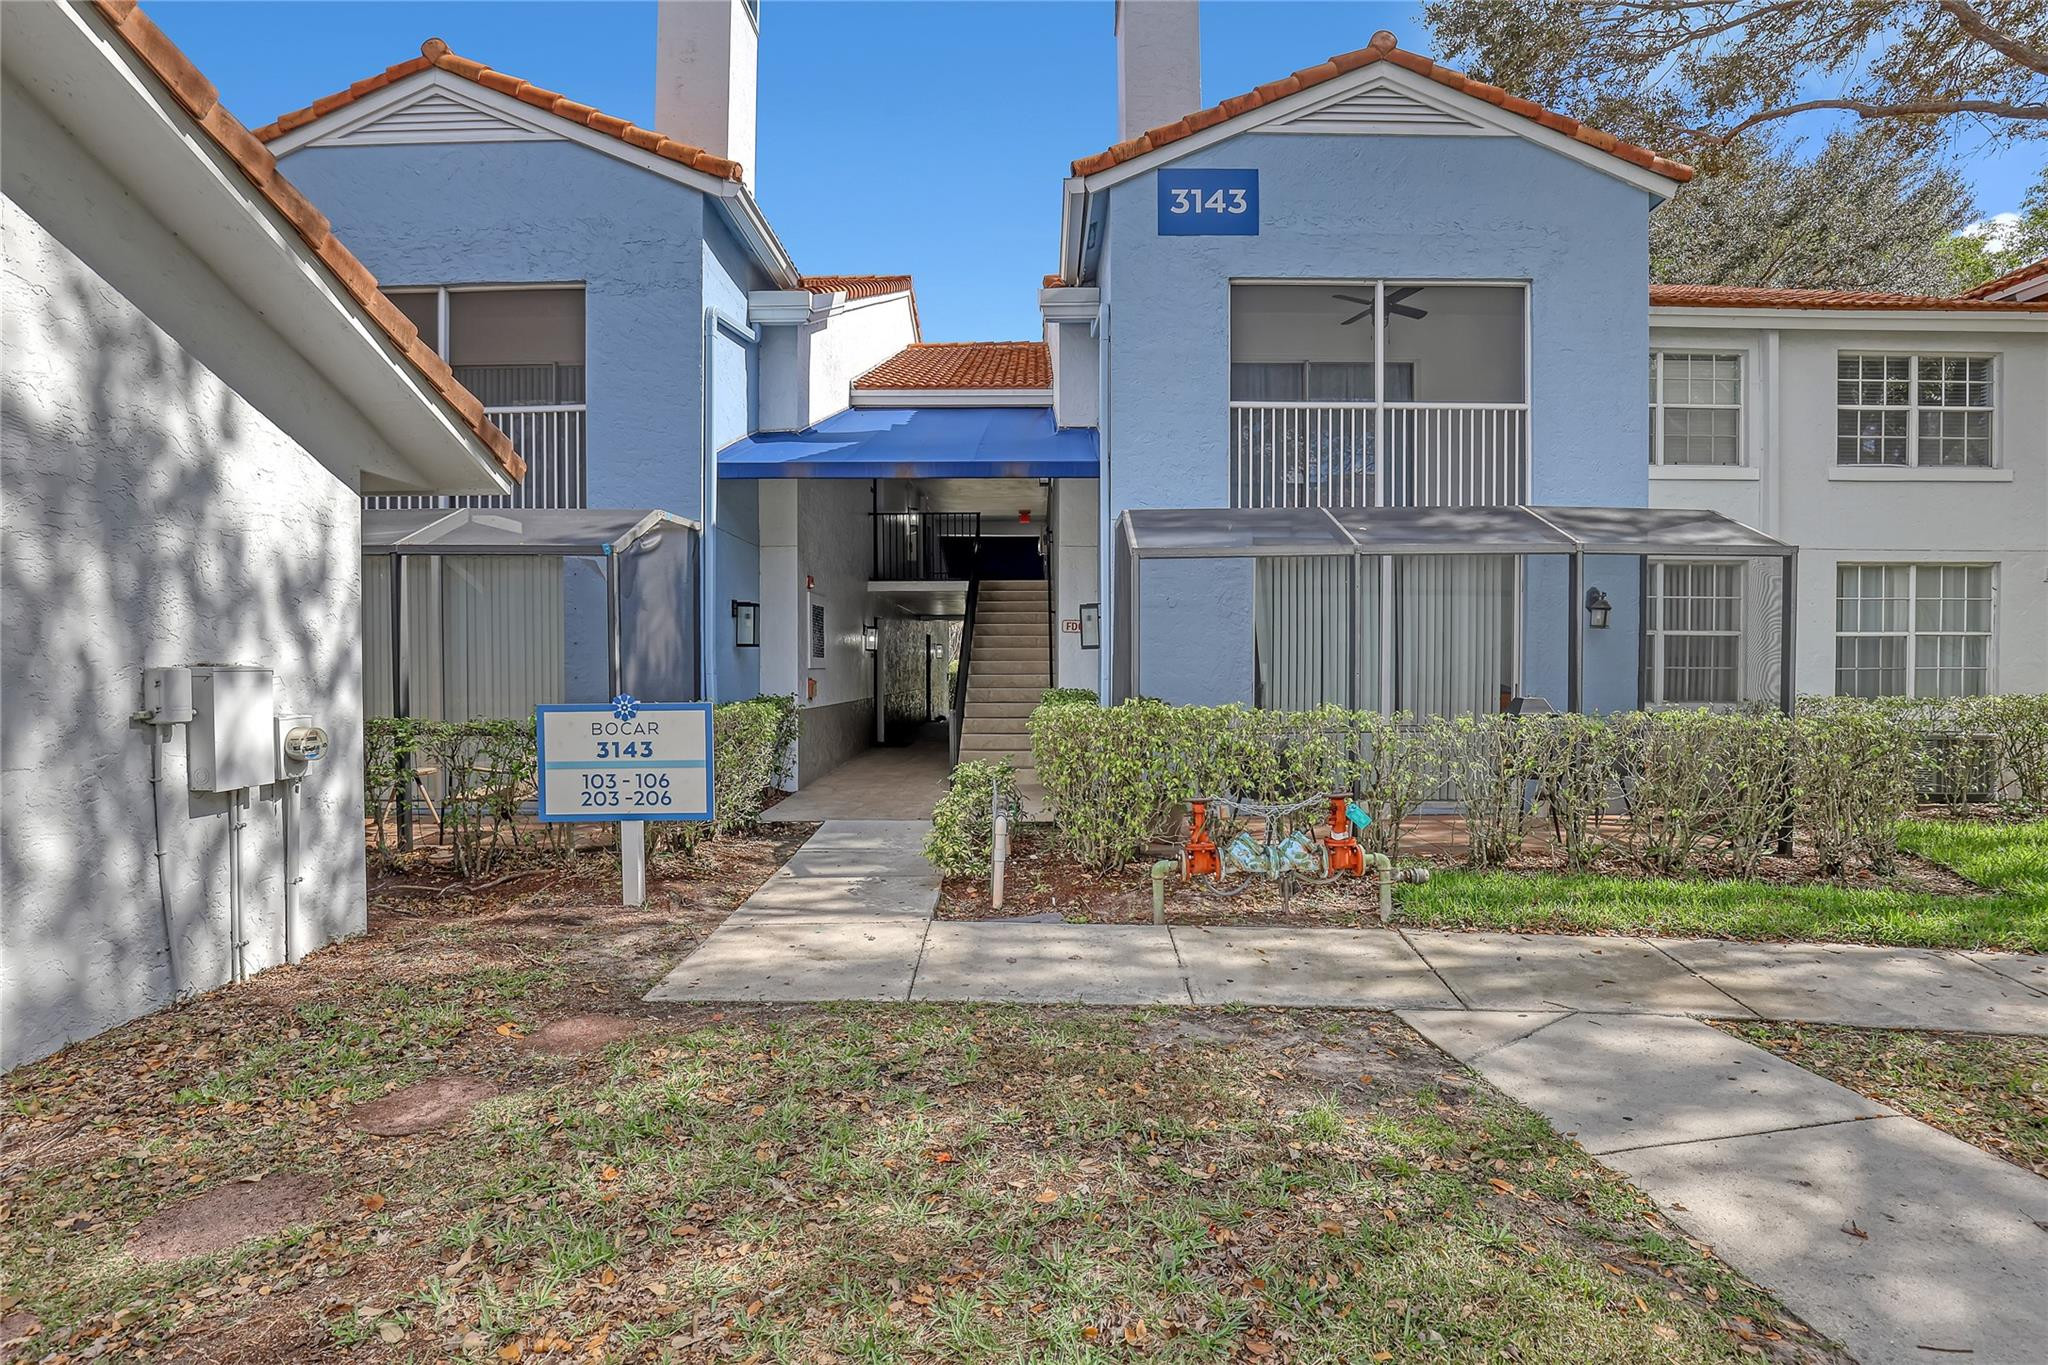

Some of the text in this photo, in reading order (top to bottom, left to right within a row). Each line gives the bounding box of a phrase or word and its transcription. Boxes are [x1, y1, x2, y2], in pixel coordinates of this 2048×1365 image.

[1170, 189, 1247, 214] 3143
[591, 722, 659, 735] BOCAR
[597, 742, 653, 758] 3143
